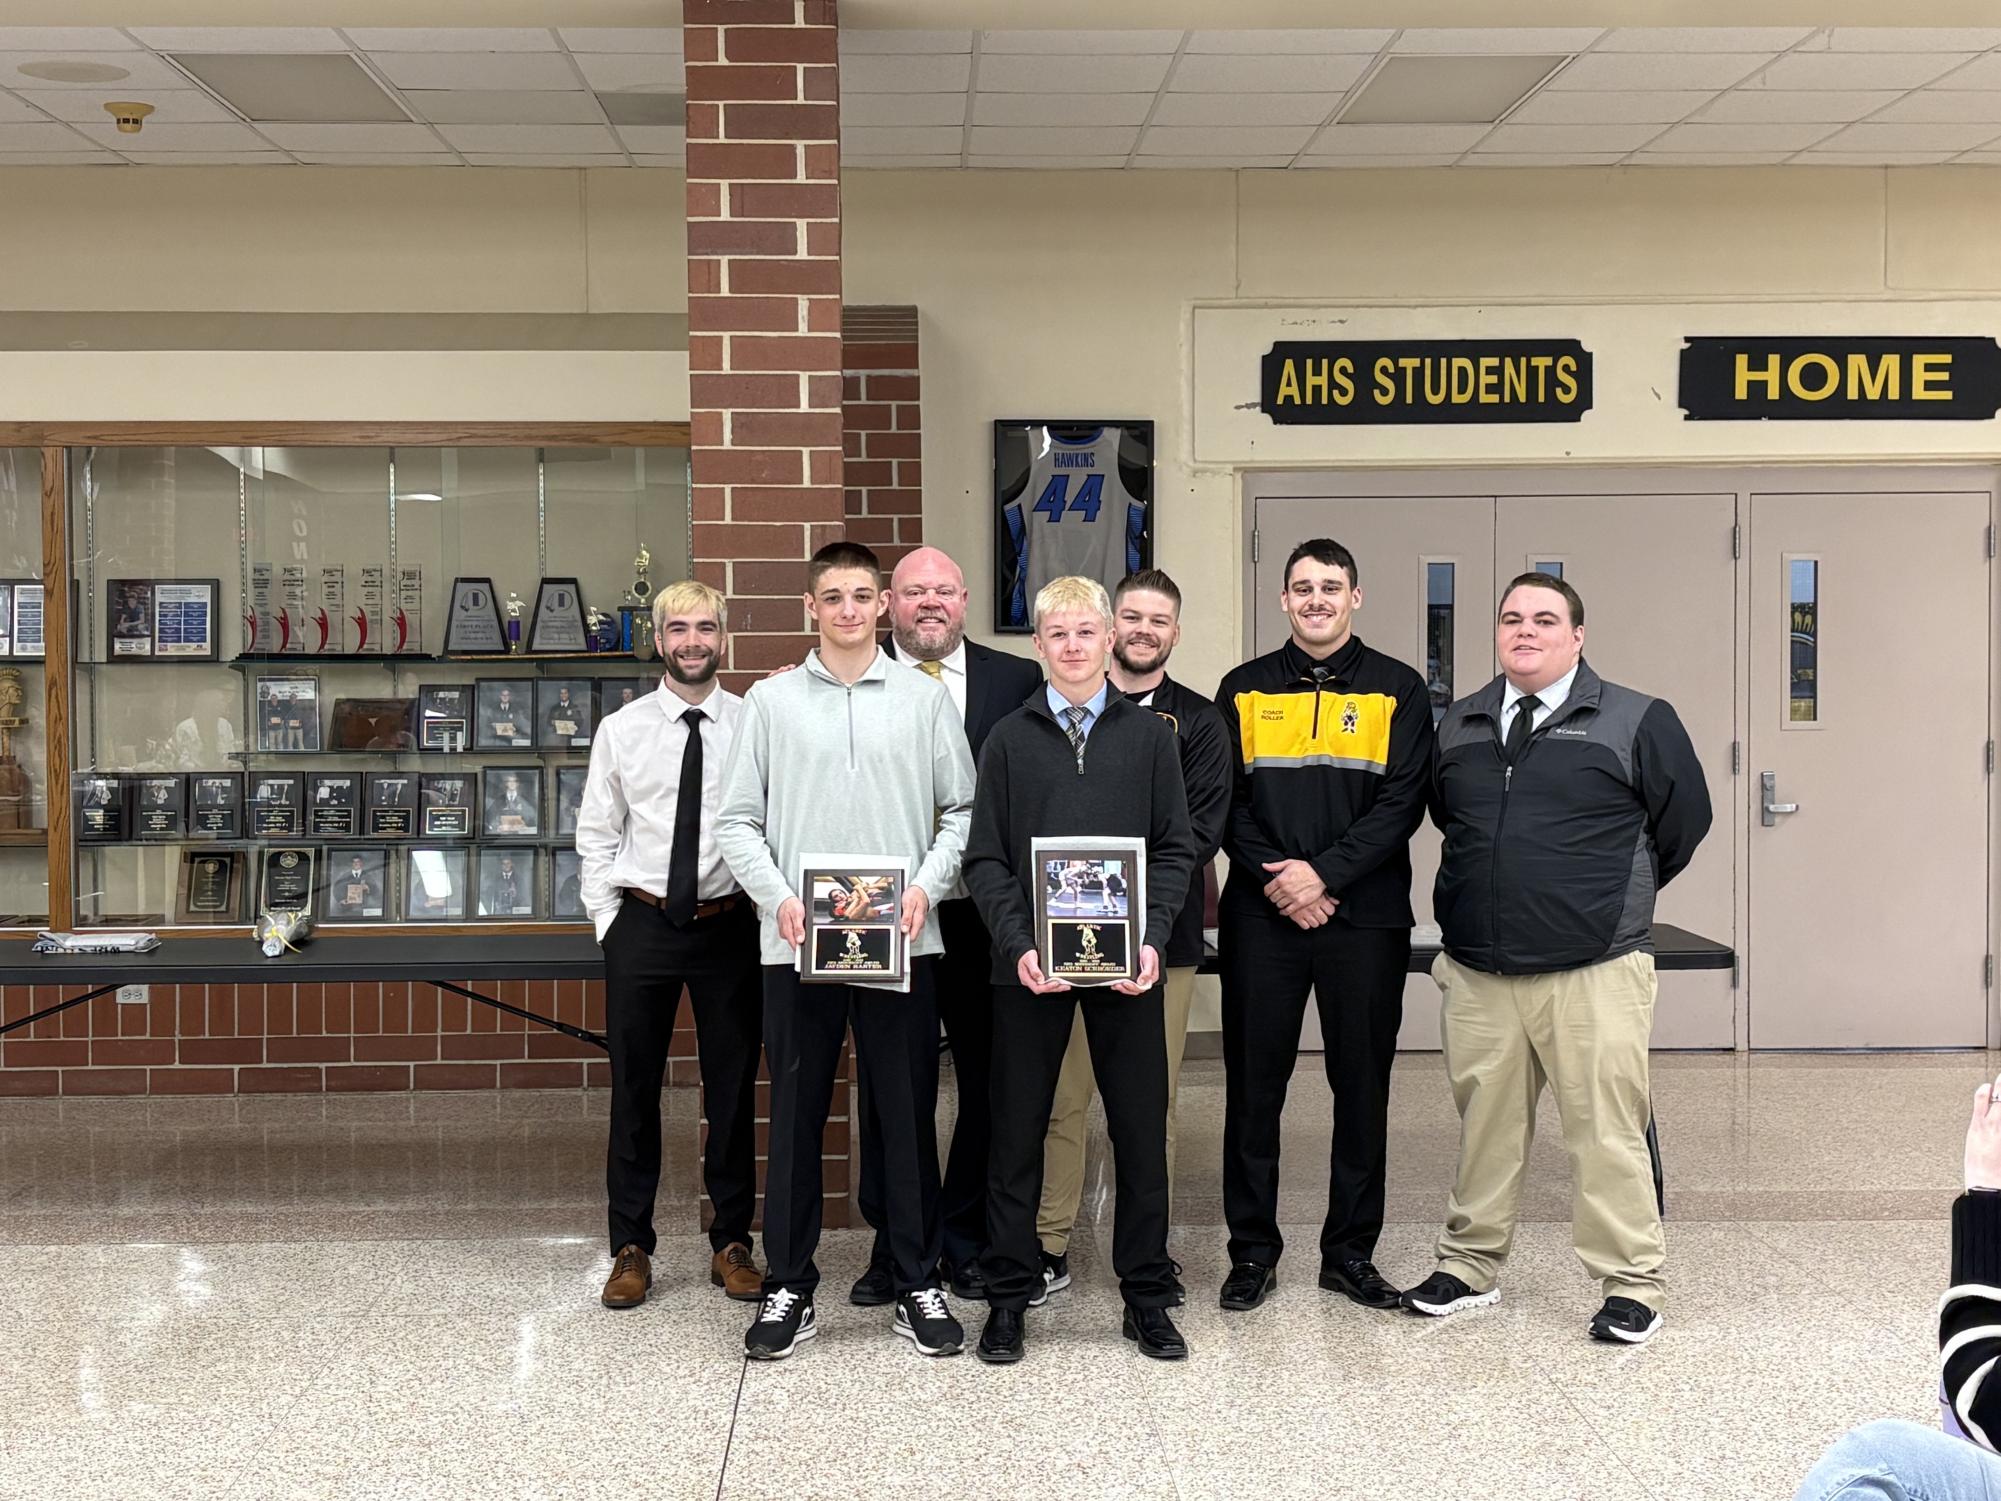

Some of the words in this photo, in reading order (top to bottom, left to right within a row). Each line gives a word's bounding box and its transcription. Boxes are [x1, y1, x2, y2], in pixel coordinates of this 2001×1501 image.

[1276, 357, 1355, 406] AHS
[1373, 355, 1578, 406] STUDENTS
[1734, 352, 1954, 401] HOME
[1054, 452, 1095, 468] HAWKINS
[1032, 474, 1105, 523] 44
